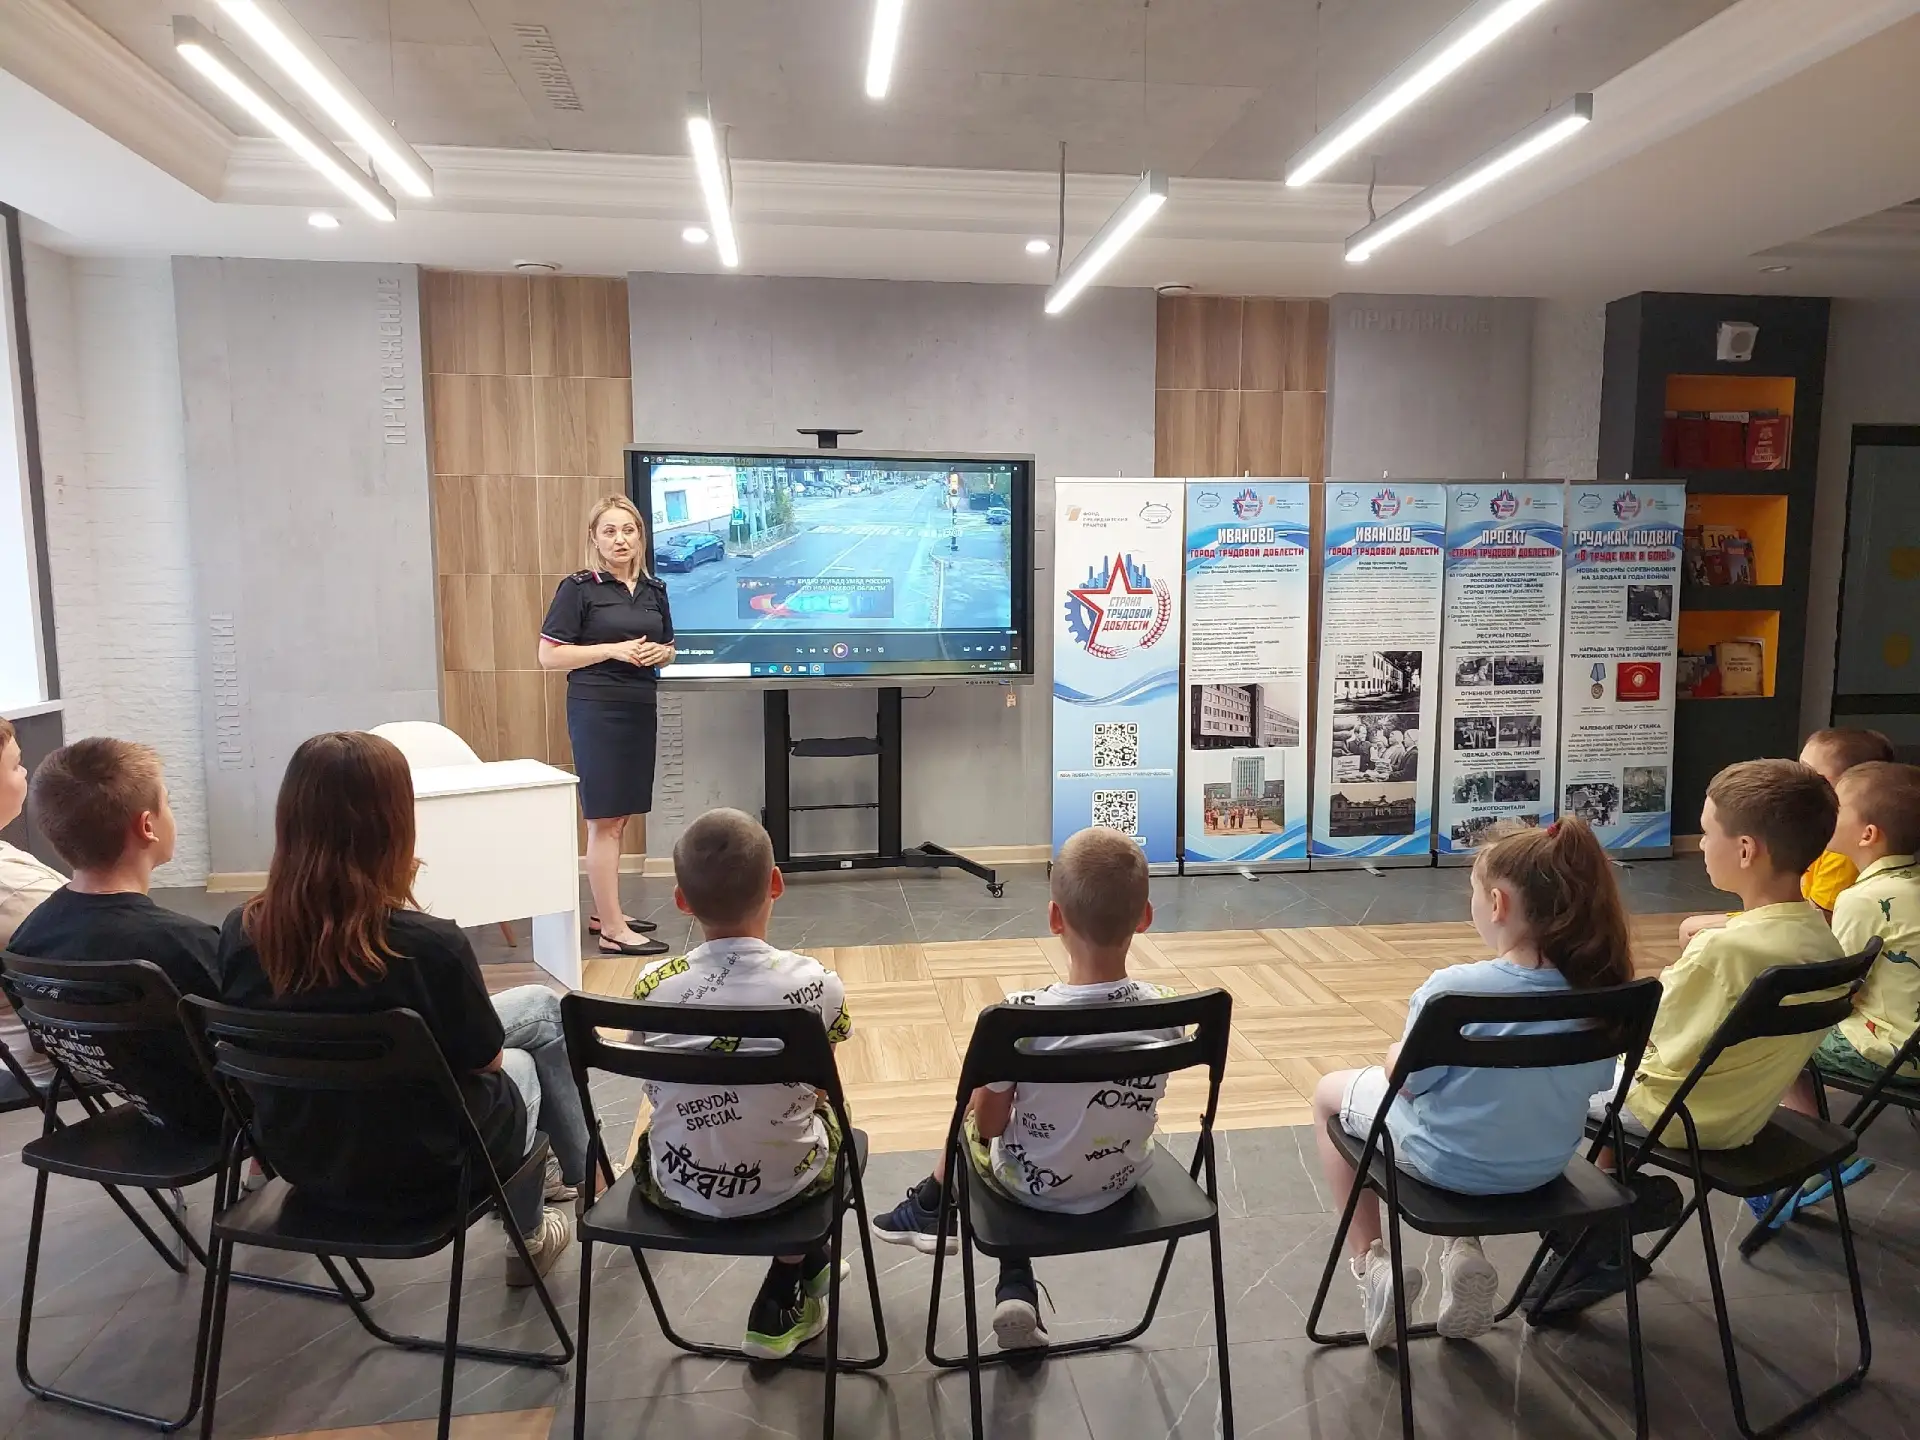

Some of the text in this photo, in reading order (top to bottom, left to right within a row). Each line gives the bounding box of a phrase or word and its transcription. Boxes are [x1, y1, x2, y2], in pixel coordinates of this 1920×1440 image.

[377, 278, 407, 445] ПРИТЯЖЕНИЕ
[1218, 528, 1275, 544] ИВАНОВО
[1355, 526, 1411, 542] ИВАНОВО
[1482, 530, 1526, 545] ПРОЕКТ
[1572, 530, 1678, 547] ТРУД КАК ПОДВИГ
[1190, 547, 1304, 558] ГОРОД ТРУДОВОЙ ДОБЛЕСТИ
[1328, 546, 1439, 556] ГОРОД ТРУДОВОЙ ДОБЛЕСТИ
[1480, 546, 1516, 558] ТРУДОВОЙ
[1590, 552, 1618, 561] ТРУДЕ
[1619, 552, 1636, 560] КАК
[1108, 596, 1142, 607] СТРАНА
[1106, 607, 1153, 619] ТРУДОВОЙ
[1102, 620, 1150, 632] ДОБЛЕСТИ
[209, 610, 243, 770] ПРИТЯЖЕНИЕ
[677, 1090, 740, 1117] EVERYDAY
[686, 1107, 742, 1132] SPECIAL
[1024, 1112, 1037, 1121] NO
[1022, 1119, 1056, 1132] RULES
[1028, 1130, 1050, 1139] HERE
[661, 1151, 762, 1200] URBAN
